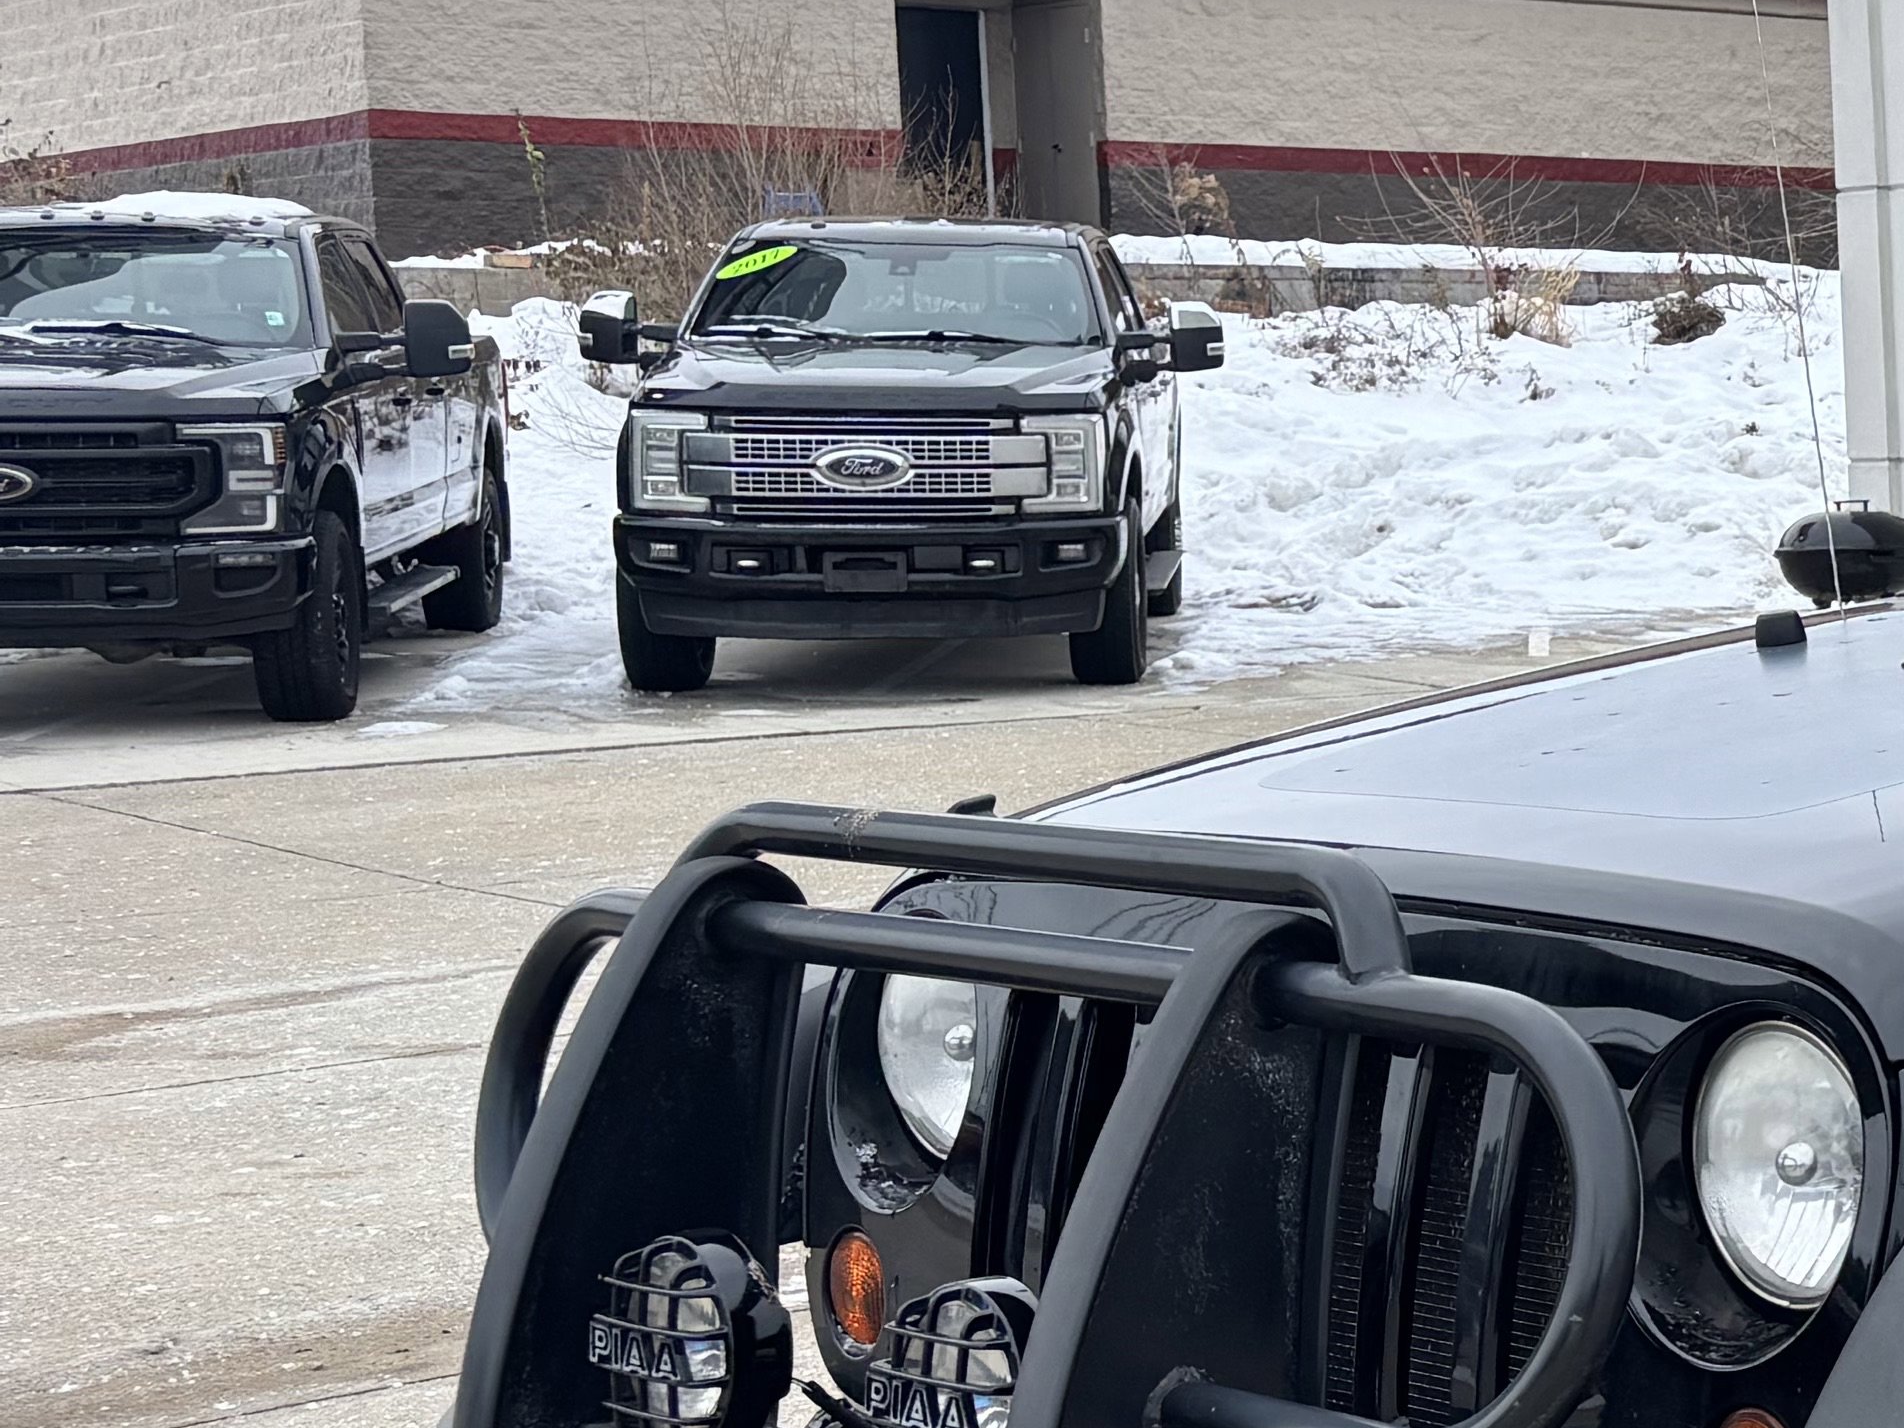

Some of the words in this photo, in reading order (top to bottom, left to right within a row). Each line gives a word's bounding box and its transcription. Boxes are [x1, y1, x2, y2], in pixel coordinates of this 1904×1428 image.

[733, 249, 779, 274] 2017
[841, 458, 884, 475] Ford
[590, 1321, 680, 1381] PIAA
